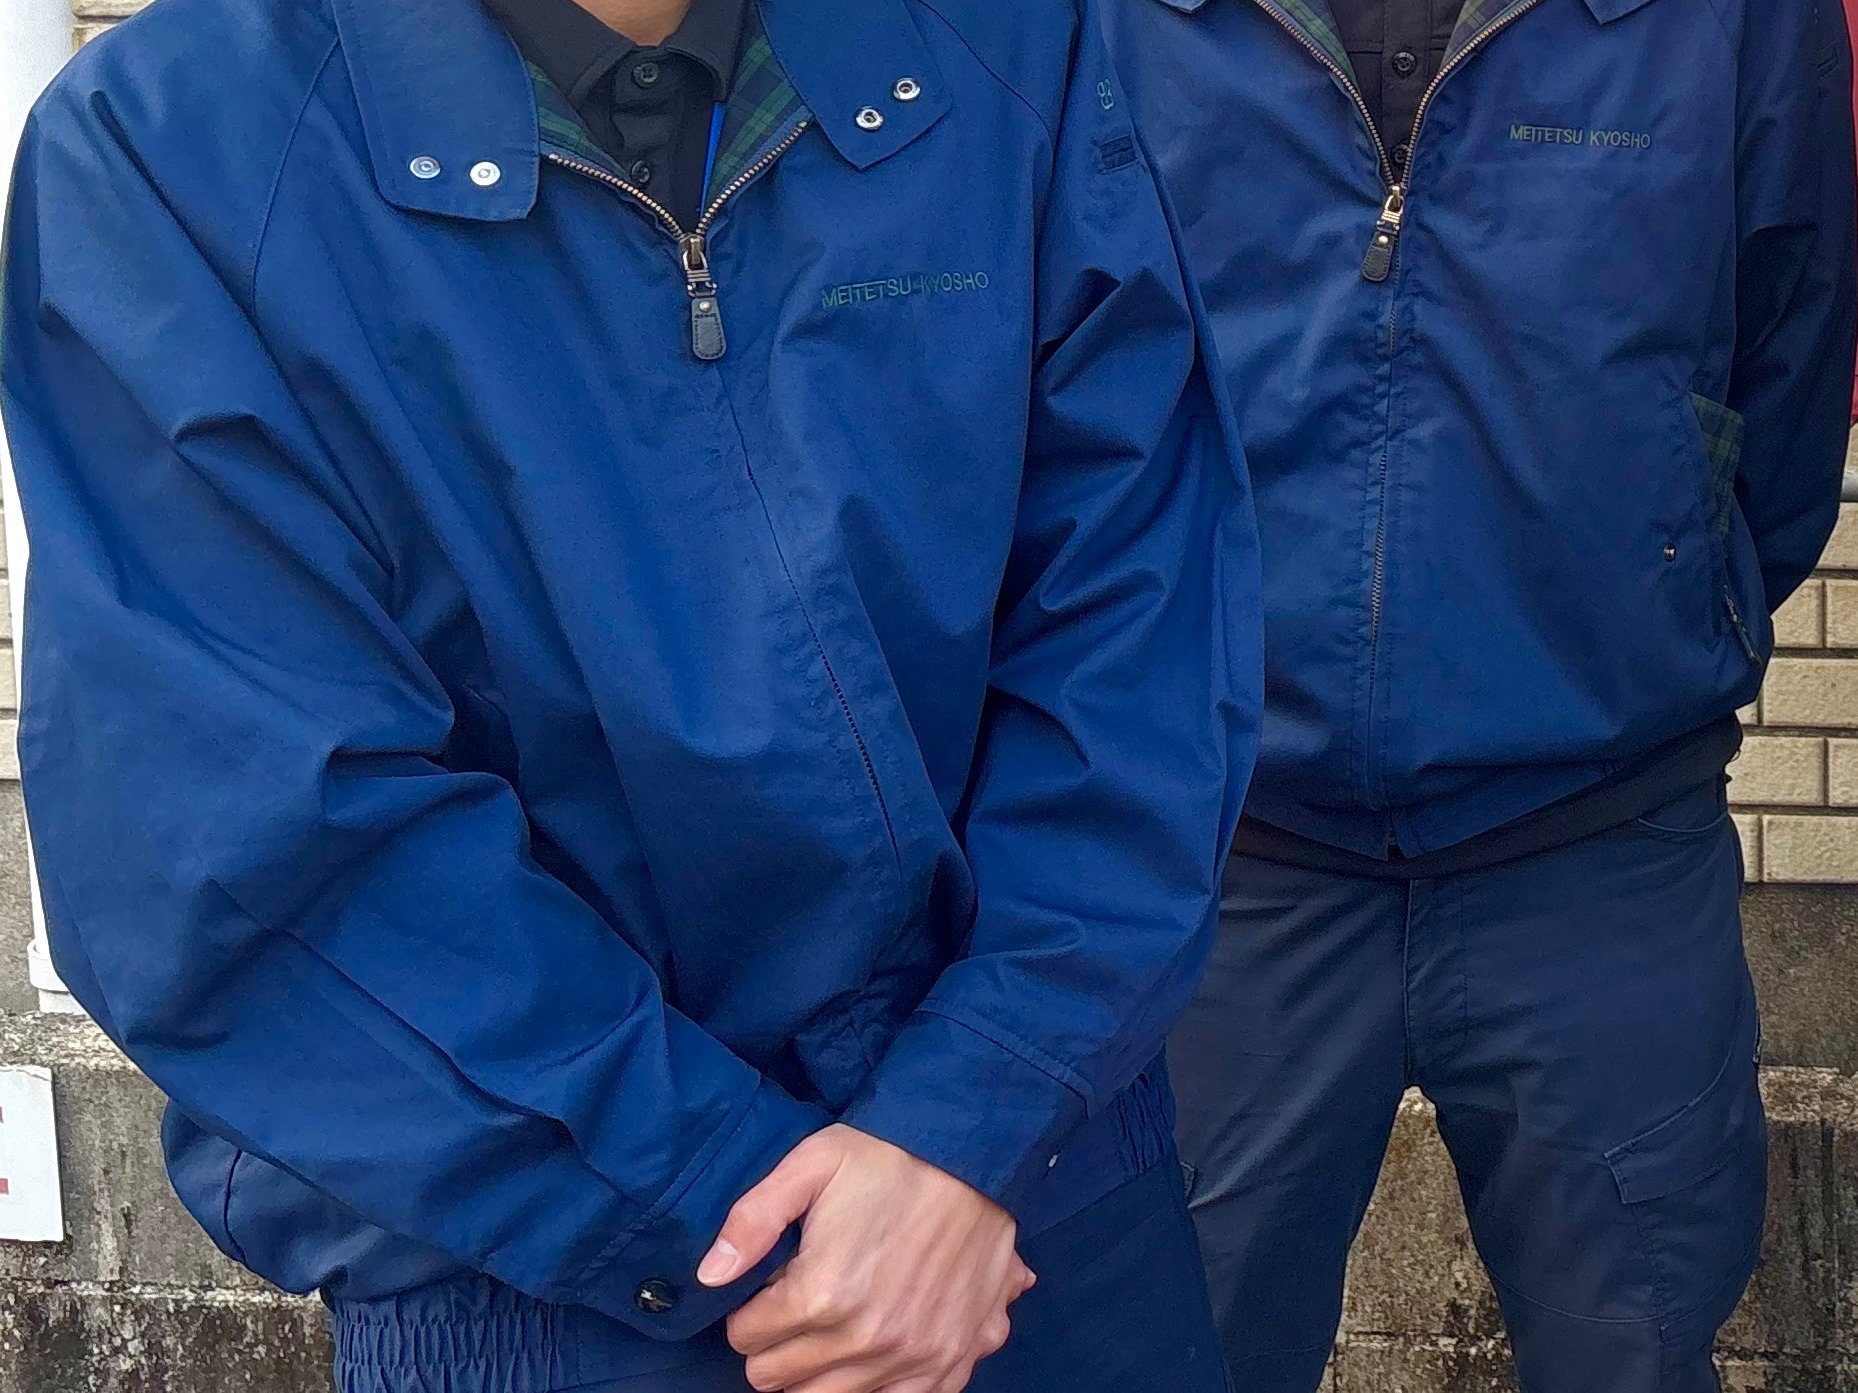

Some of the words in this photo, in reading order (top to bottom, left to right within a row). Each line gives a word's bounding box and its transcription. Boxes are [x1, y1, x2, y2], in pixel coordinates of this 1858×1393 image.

[1510, 125, 1583, 144] MEITETSU
[1589, 130, 1651, 149] KYOSHO
[821, 277, 912, 308] MEITETSU
[919, 271, 989, 295] KYOSHO
